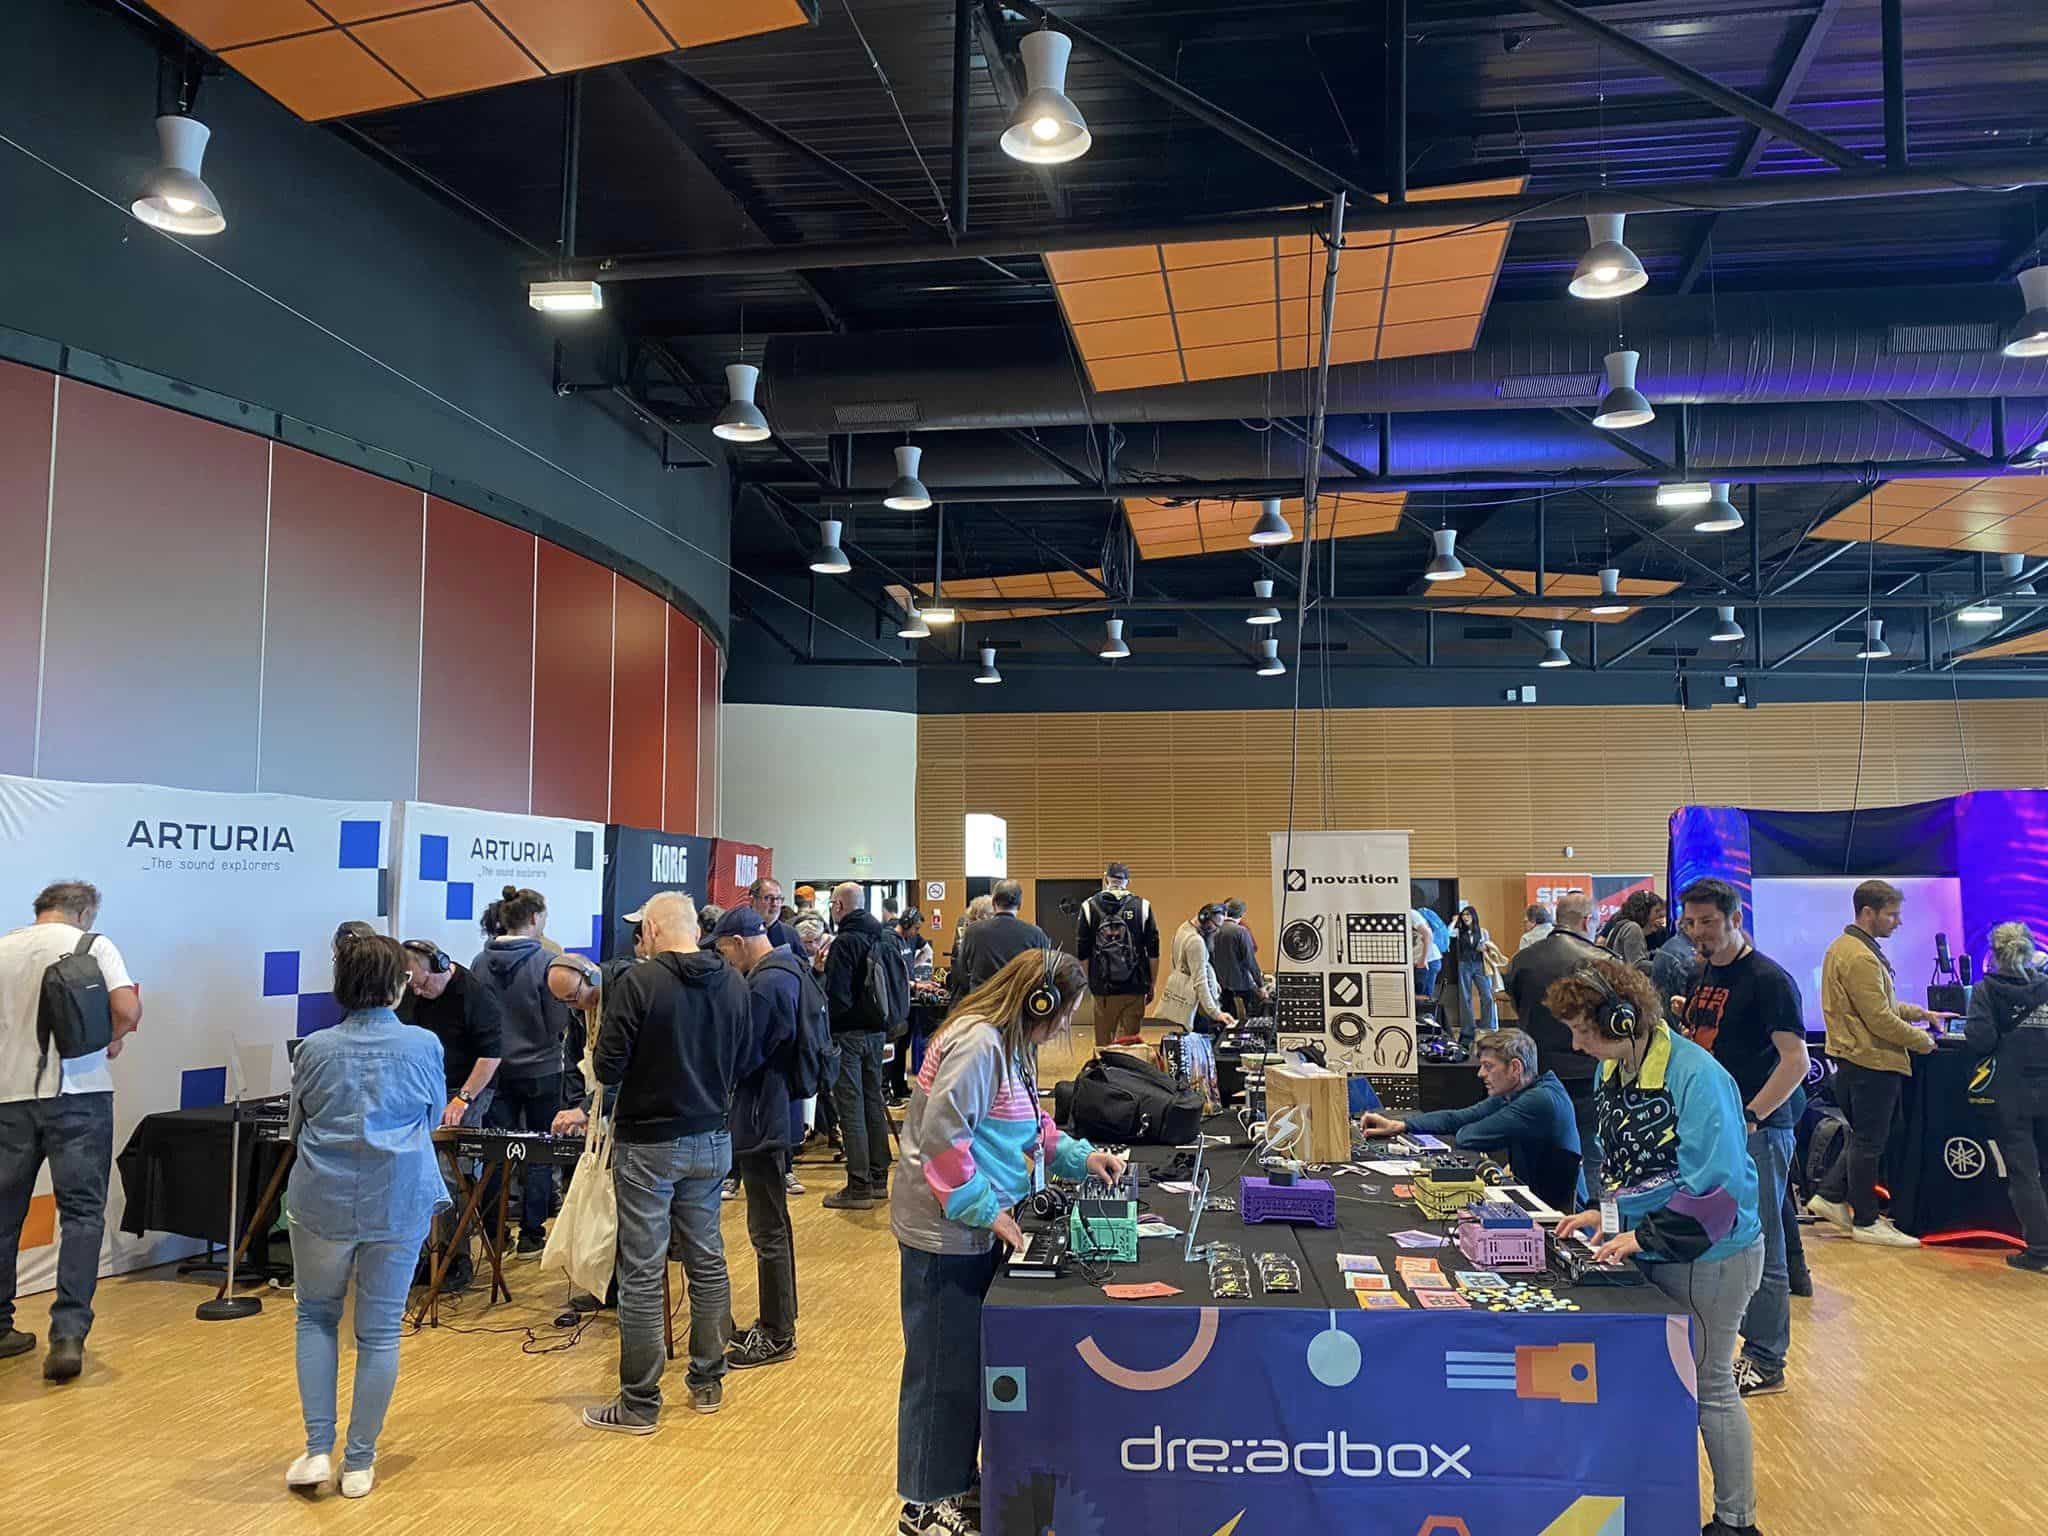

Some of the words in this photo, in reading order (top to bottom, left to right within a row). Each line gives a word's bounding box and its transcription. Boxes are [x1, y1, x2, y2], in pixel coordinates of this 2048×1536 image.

[127, 820, 295, 852] ARTURIA
[470, 838, 554, 862] ARTURIA
[180, 858, 215, 871] sound
[221, 859, 281, 872] explorers
[651, 843, 688, 883] KORG
[1311, 874, 1399, 884] novation
